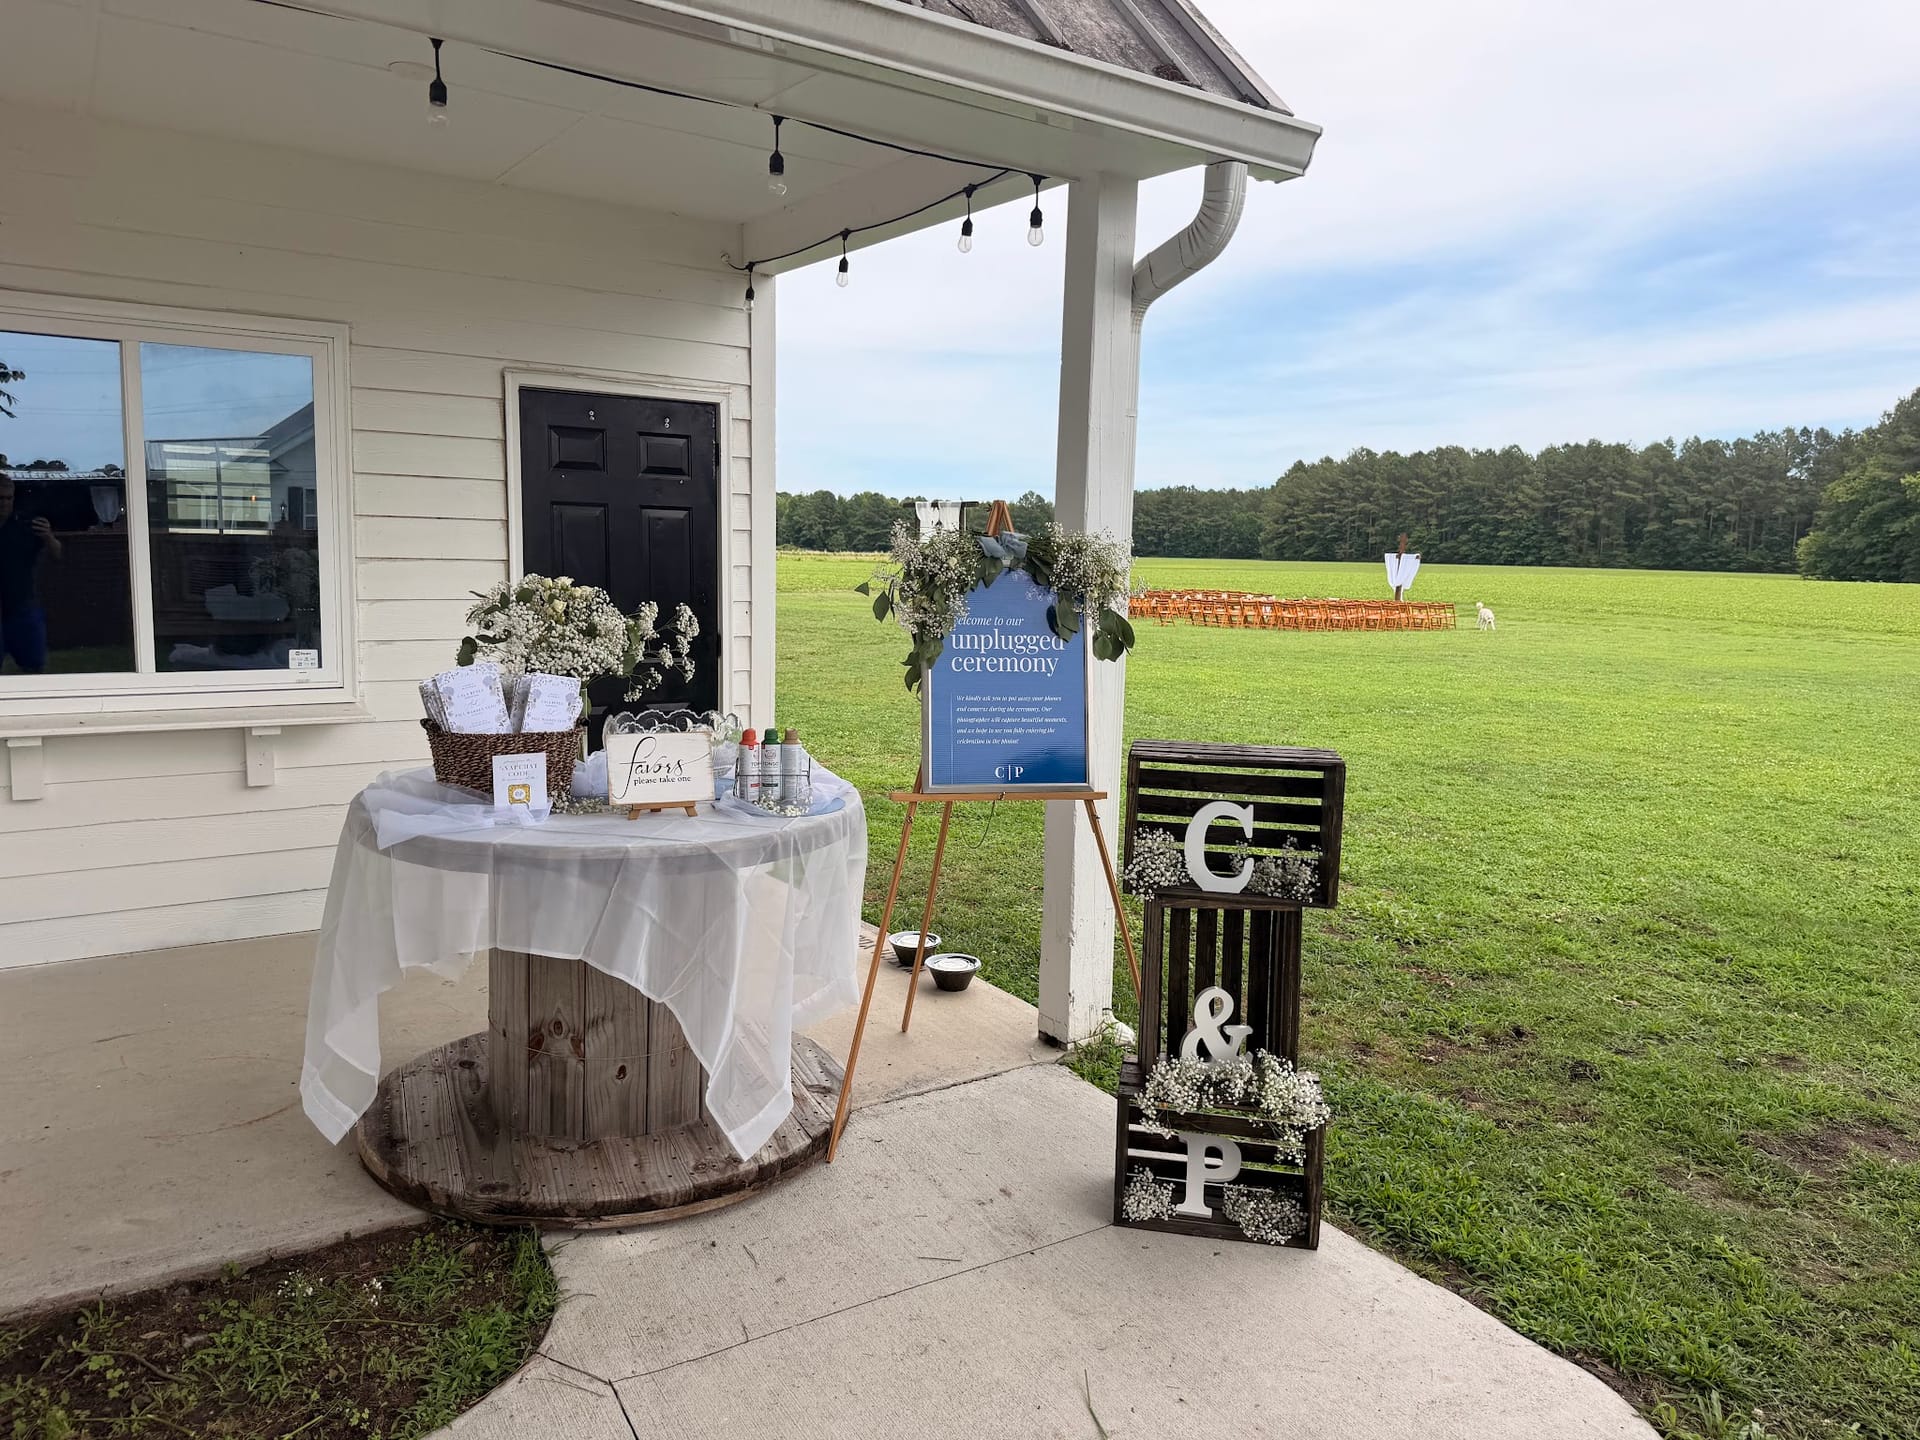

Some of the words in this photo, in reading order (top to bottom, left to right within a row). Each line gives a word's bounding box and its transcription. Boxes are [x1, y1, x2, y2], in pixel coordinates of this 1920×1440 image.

[951, 628, 1065, 654] unplugged
[994, 616, 1003, 626] to
[1006, 618, 1024, 626] our
[951, 656, 1059, 677] ceremony
[611, 736, 711, 799] favors
[633, 776, 657, 787] please
[659, 775, 676, 783] take
[1184, 801, 1254, 894] C
[1180, 985, 1253, 1064] &
[1176, 1131, 1242, 1219] P
